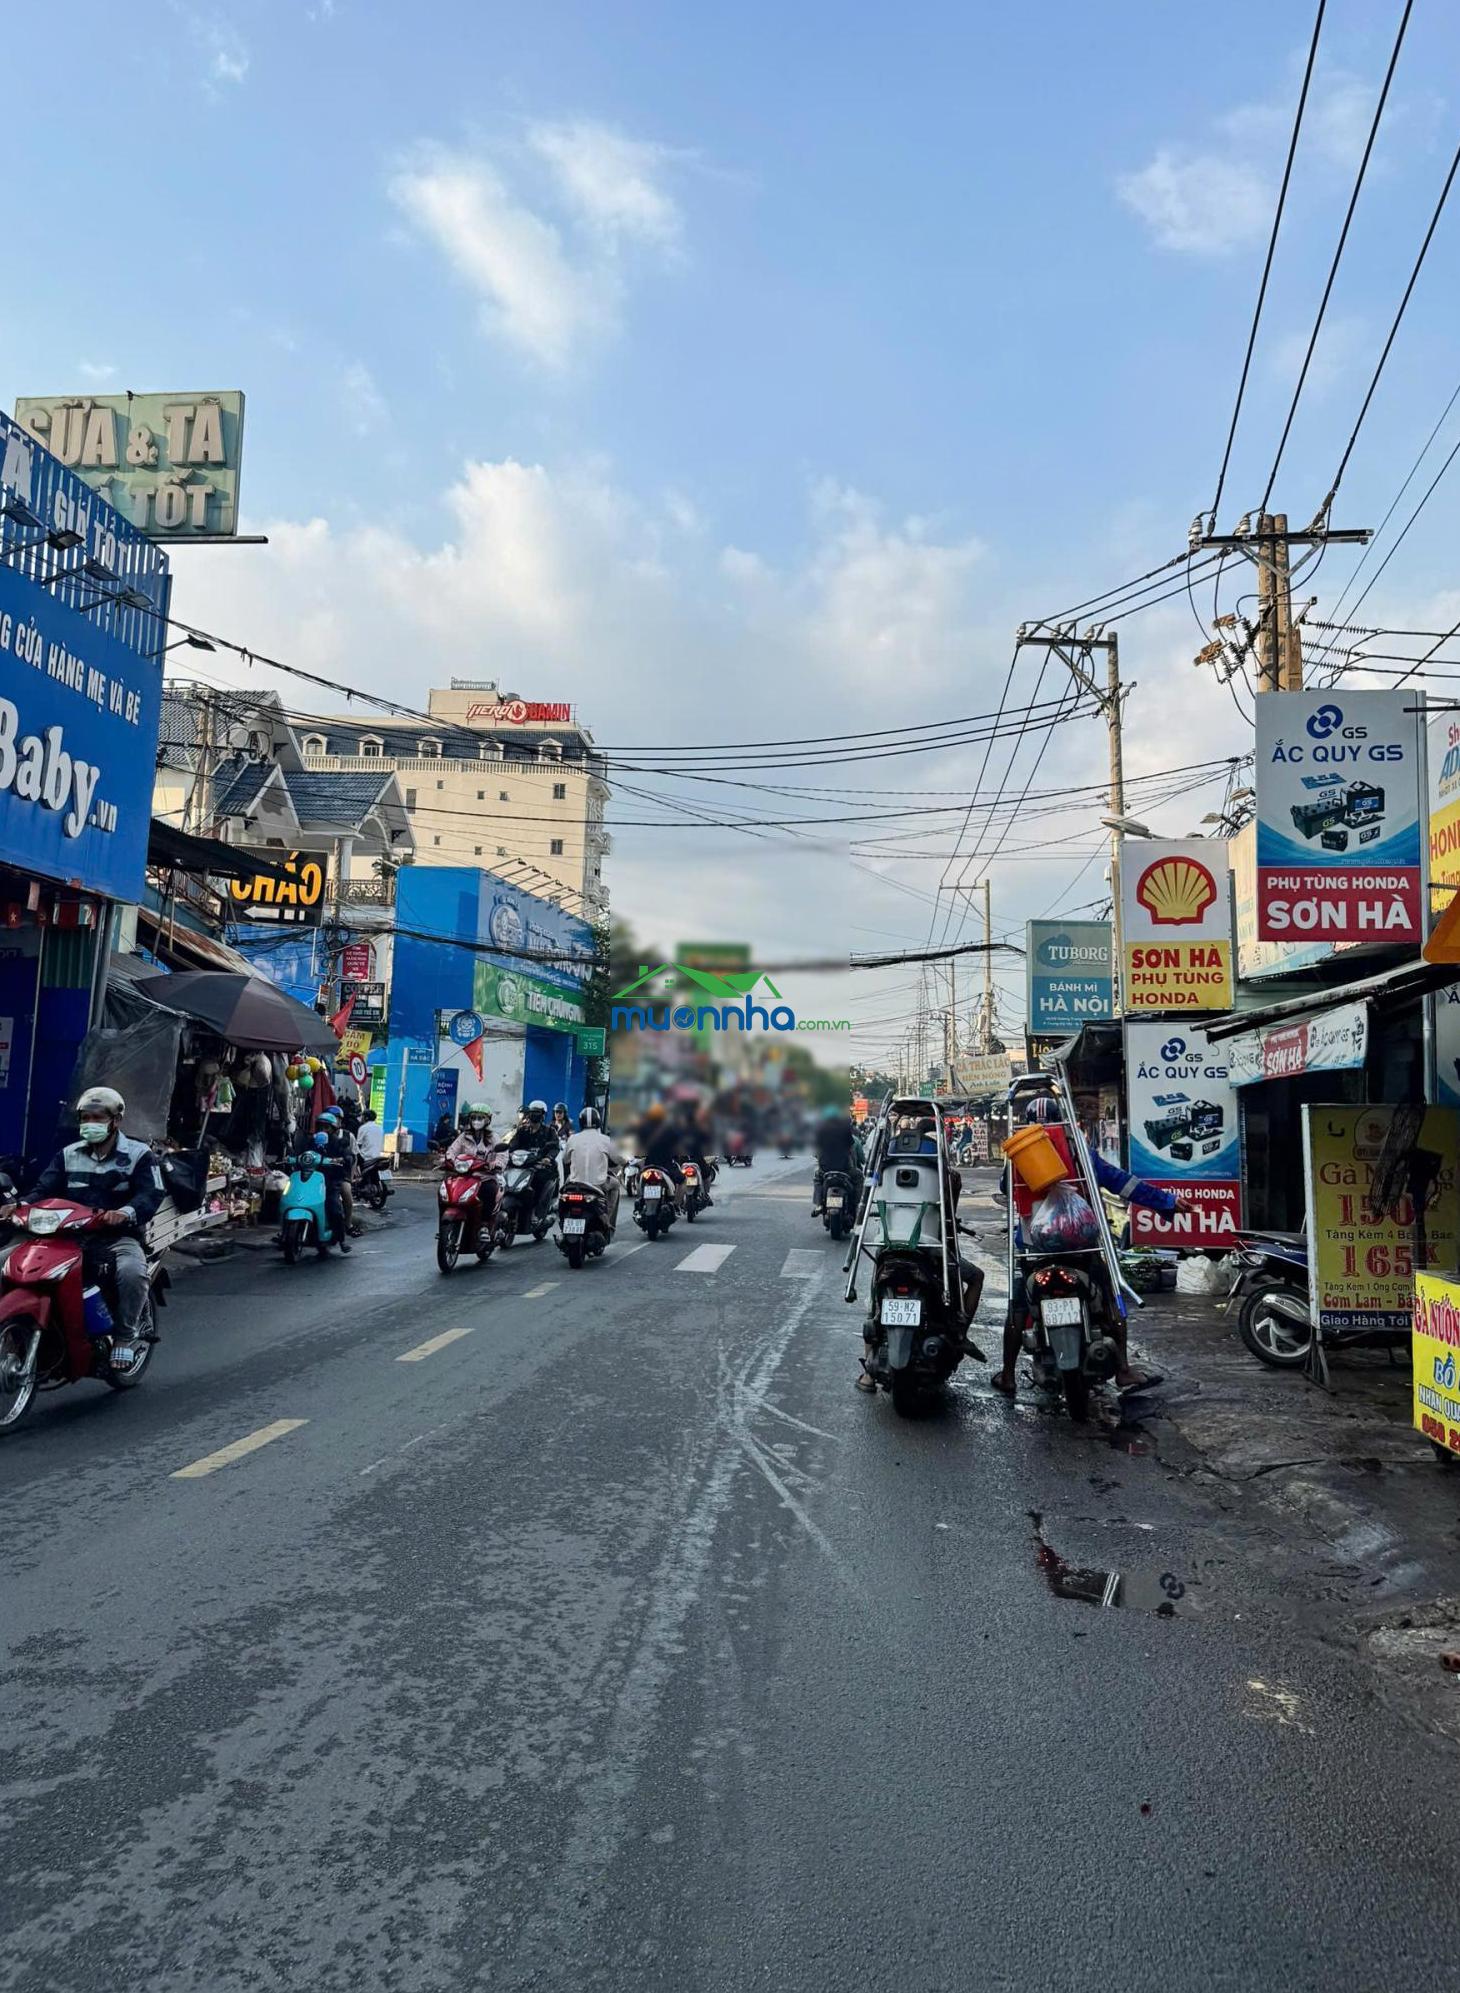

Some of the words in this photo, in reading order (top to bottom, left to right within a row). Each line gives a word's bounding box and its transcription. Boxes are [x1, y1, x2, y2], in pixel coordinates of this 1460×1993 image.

[127, 425, 158, 466] &
[130, 468, 216, 529] TỐT
[15, 615, 42, 670] CỬA
[47, 641, 84, 693] HÀNG
[87, 667, 106, 713] MẸ
[109, 677, 123, 716] VÀ
[125, 689, 141, 726] BÉ
[1342, 726, 1368, 739] GS
[1271, 738, 1304, 763] ẮC
[1312, 745, 1362, 763] QUY
[1368, 744, 1404, 762] GS
[1319, 789, 1337, 798] GS
[1267, 876, 1300, 893] PHỤ
[1304, 872, 1348, 889] TÙNG
[1352, 876, 1410, 890] HONDA
[1266, 897, 1347, 930] SƠN
[1358, 893, 1413, 930] HÀ
[1048, 945, 1109, 961] TUBORG
[1131, 948, 1181, 968] SƠN
[1189, 944, 1223, 968] HÀ
[1049, 981, 1082, 992] BÁNH
[1131, 973, 1166, 988] PHỤ
[1173, 969, 1224, 985] TÙNG
[1040, 993, 1069, 1012] HÀ
[1073, 993, 1109, 1016] NỘI
[1132, 992, 1200, 1005] HONDA
[1185, 1053, 1203, 1062] GS
[353, 1062, 363, 1076] 10
[1137, 1061, 1159, 1079] ẮC
[1165, 1067, 1199, 1079] QUY
[1204, 1067, 1229, 1079] GS
[1320, 1162, 1356, 1184] Gà
[1194, 1188, 1236, 1200] HONDA
[1199, 1205, 1236, 1233] HÀ
[1324, 1293, 1350, 1308] Cơm
[1320, 1314, 1350, 1326] Giao
[1352, 1313, 1386, 1328] Hàng
